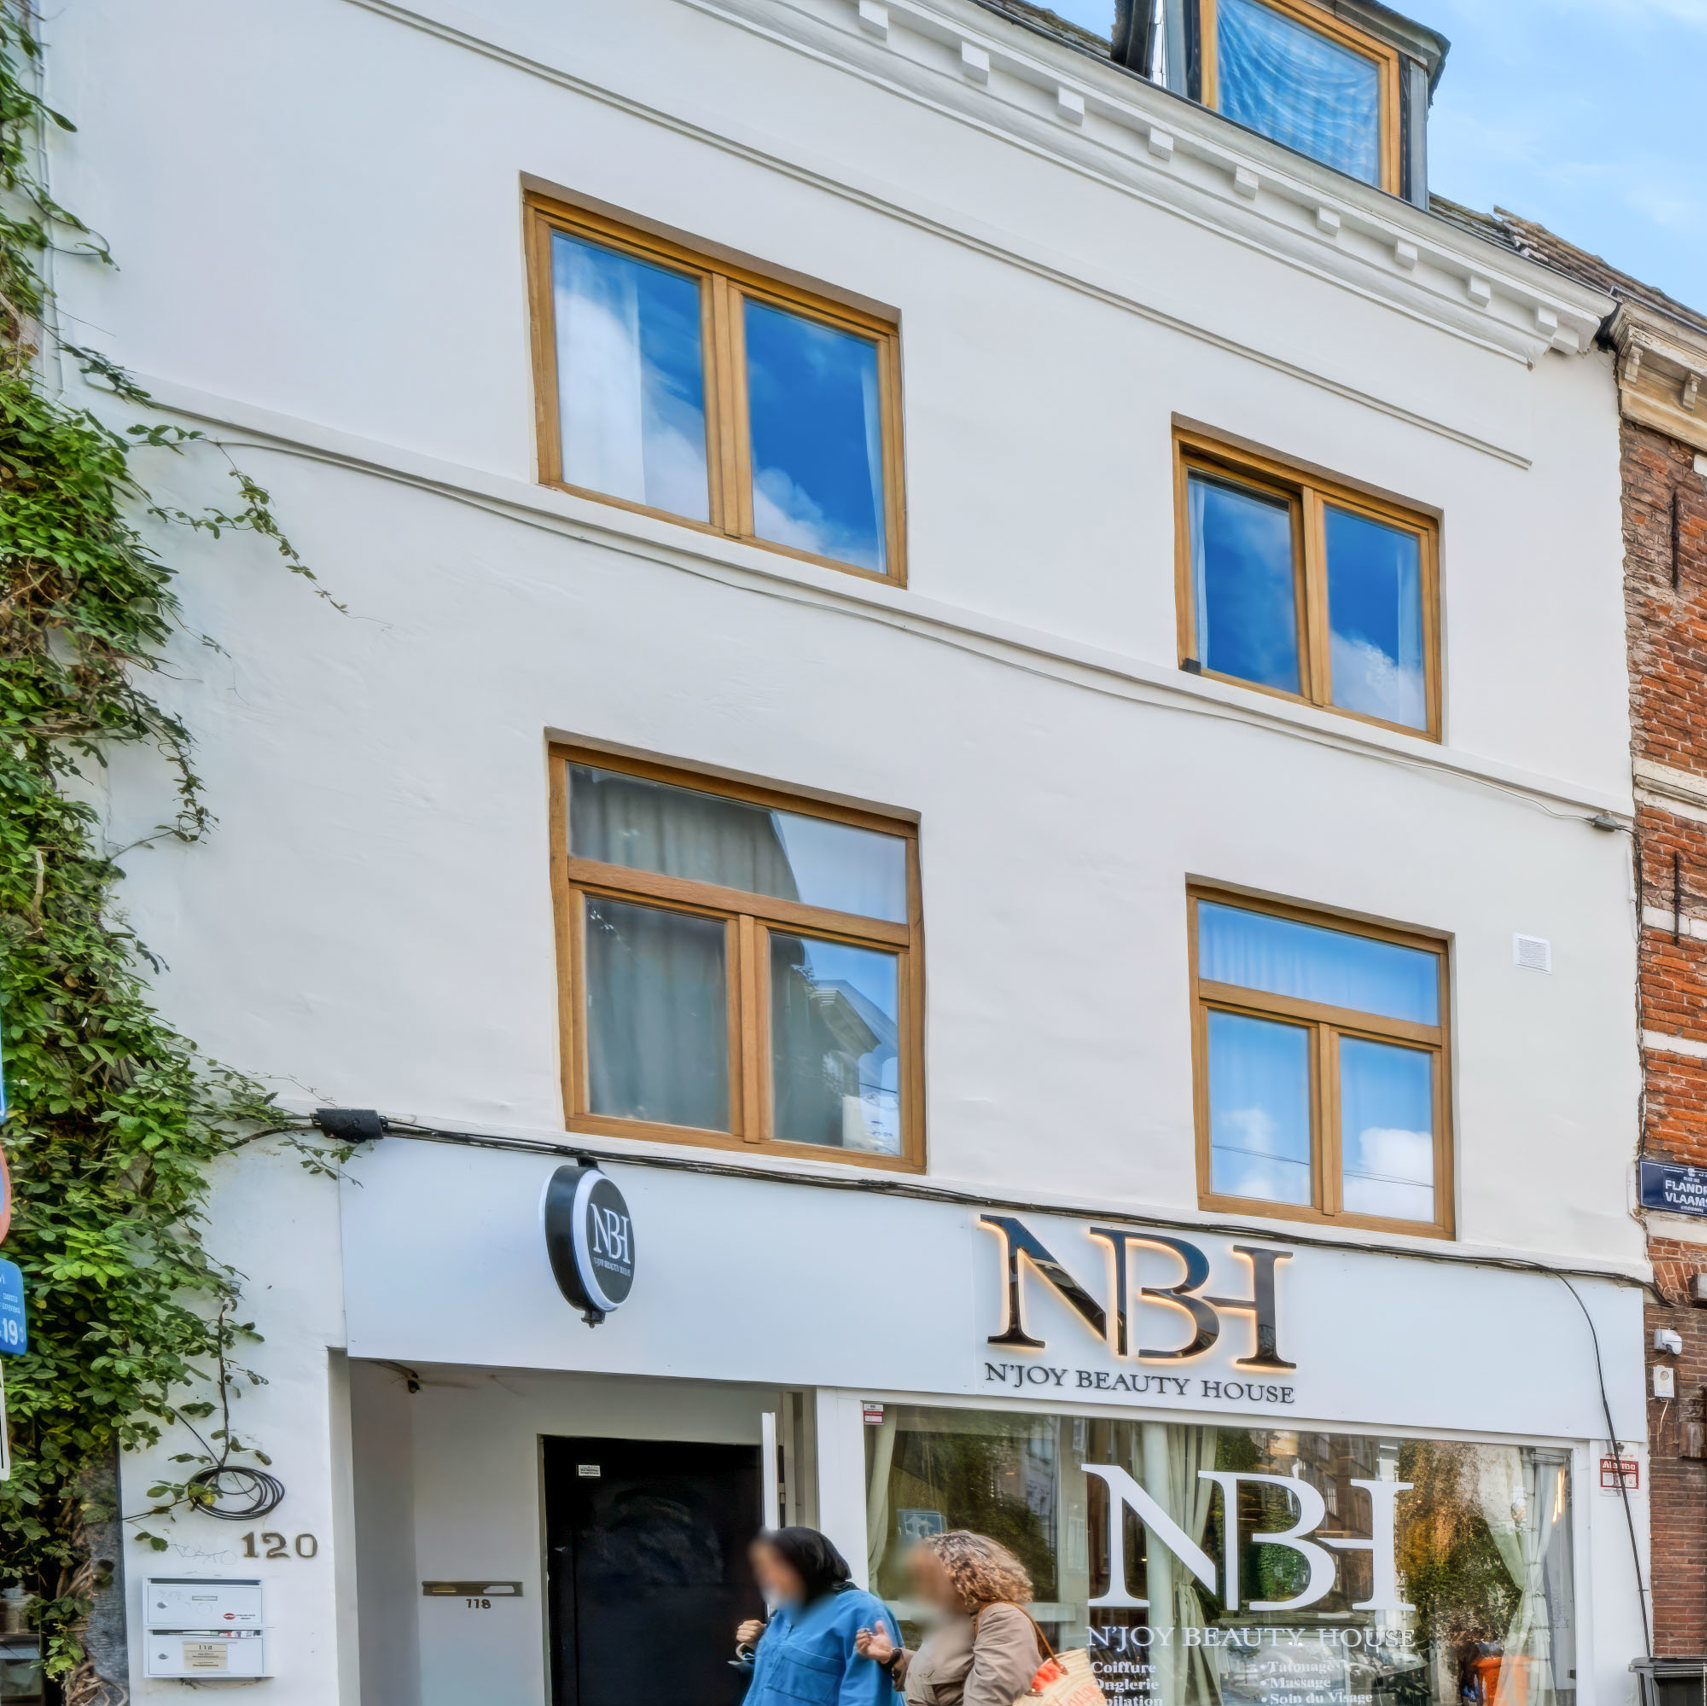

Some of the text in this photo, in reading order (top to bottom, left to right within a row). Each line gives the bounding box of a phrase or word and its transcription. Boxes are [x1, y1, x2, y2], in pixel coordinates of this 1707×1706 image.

[590, 1203, 631, 1265] NBH
[980, 1213, 1297, 1369] NBH
[984, 1362, 1295, 1404] N'JOY BEAUTY HOUSE
[241, 1531, 318, 1559] 120
[1080, 1463, 1417, 1612] NBH
[465, 1598, 492, 1609] 118
[1085, 1625, 1416, 1652] N'JOY BEAUTY HOUSE
[1091, 1660, 1156, 1674] Coiffure
[1269, 1677, 1331, 1689] Massage
[1270, 1691, 1373, 1705] Soin du Visage
